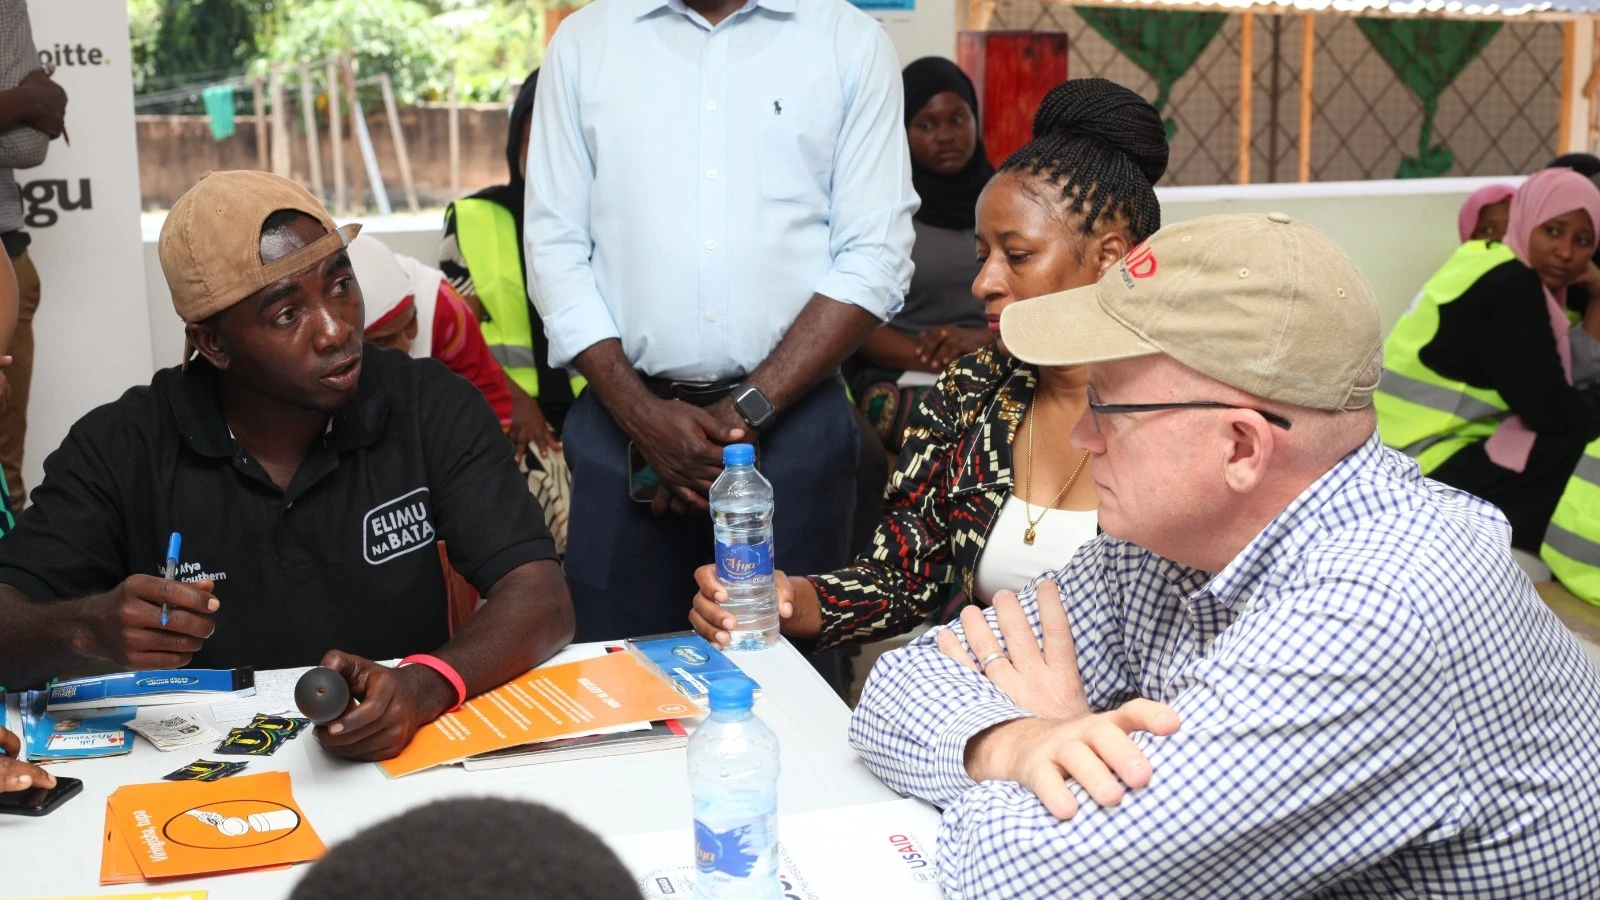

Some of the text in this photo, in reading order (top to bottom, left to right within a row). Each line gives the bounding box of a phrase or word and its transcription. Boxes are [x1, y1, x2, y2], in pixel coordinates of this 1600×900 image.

[371, 502, 427, 537] ELIMU
[371, 520, 434, 556] NA BATA
[180, 562, 201, 574] Afya
[726, 558, 756, 572] Afya
[181, 571, 227, 584] Southern
[80, 738, 95, 746] Jali
[133, 809, 152, 827] tupa
[889, 834, 927, 869] USAID
[658, 879, 674, 892] USAID
